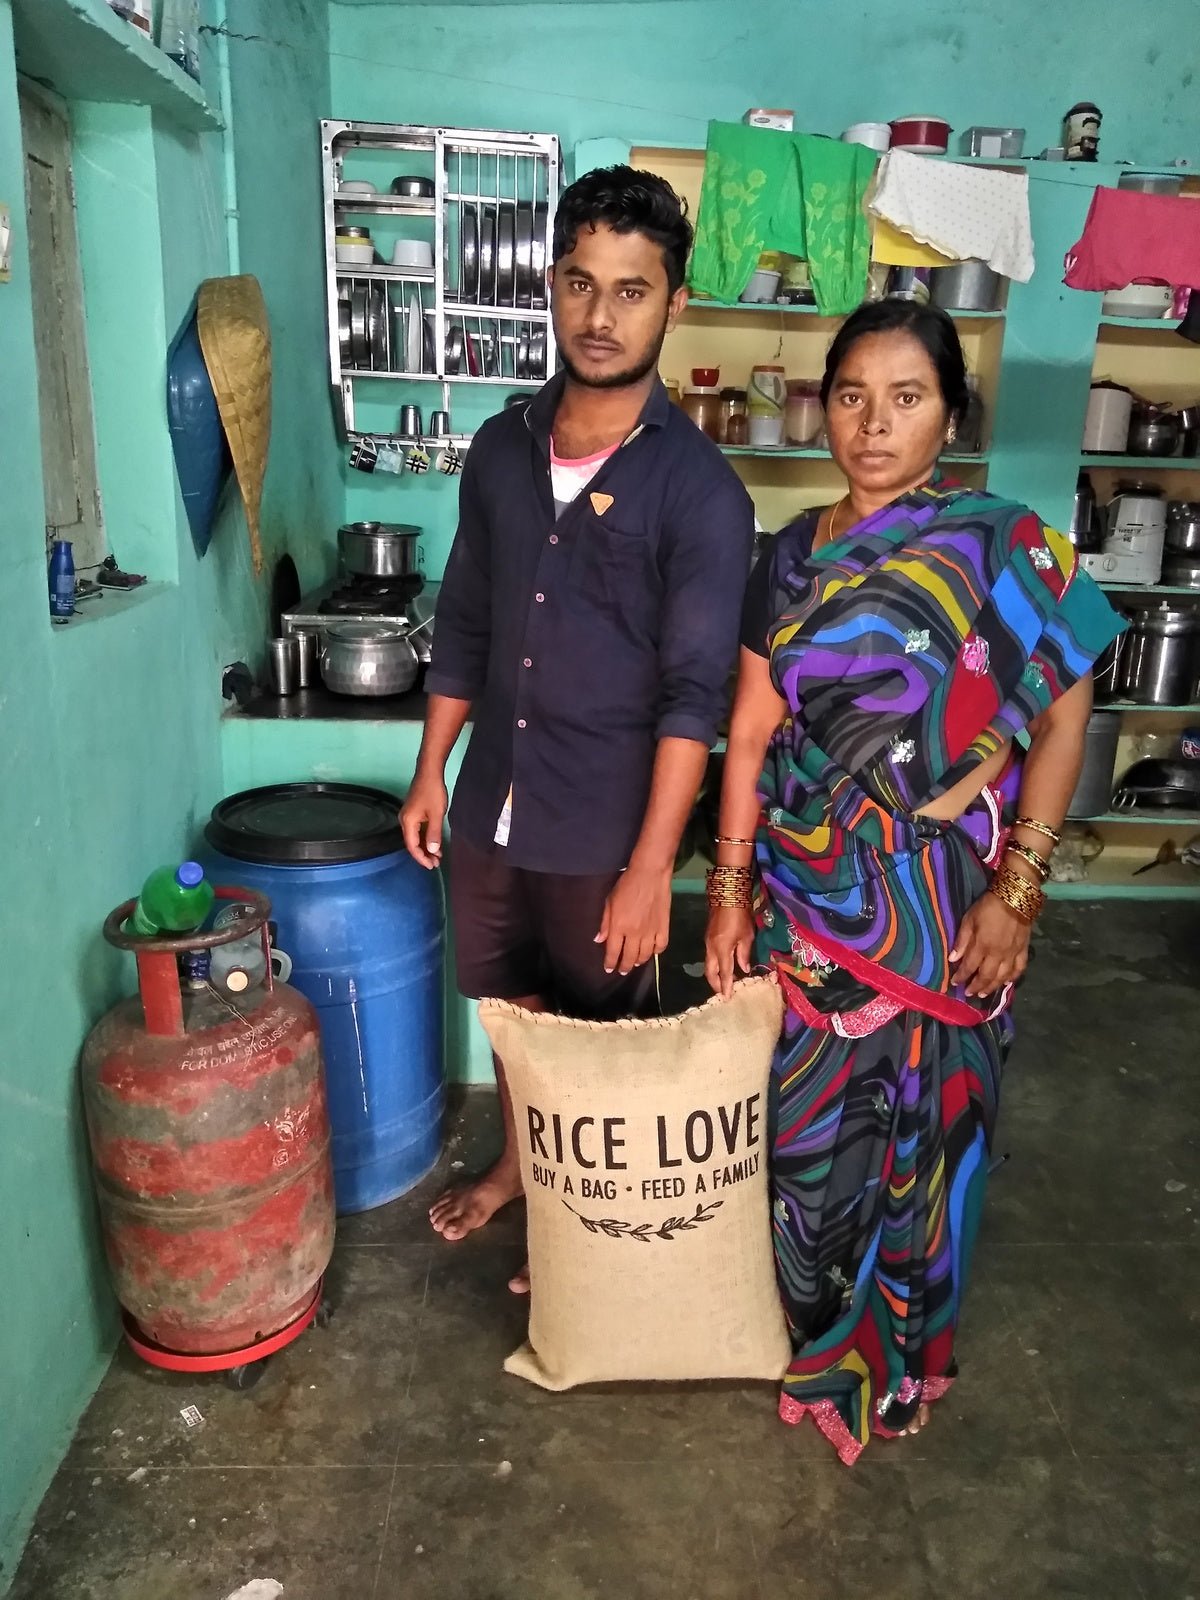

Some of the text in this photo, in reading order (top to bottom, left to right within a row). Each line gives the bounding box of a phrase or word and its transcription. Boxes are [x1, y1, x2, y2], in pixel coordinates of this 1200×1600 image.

[180, 1060, 208, 1071] FOR
[268, 1025, 287, 1043] USE
[527, 1092, 760, 1170] RICE LOVE
[532, 1151, 760, 1200] BUY A BAG FEED A FAMILY
